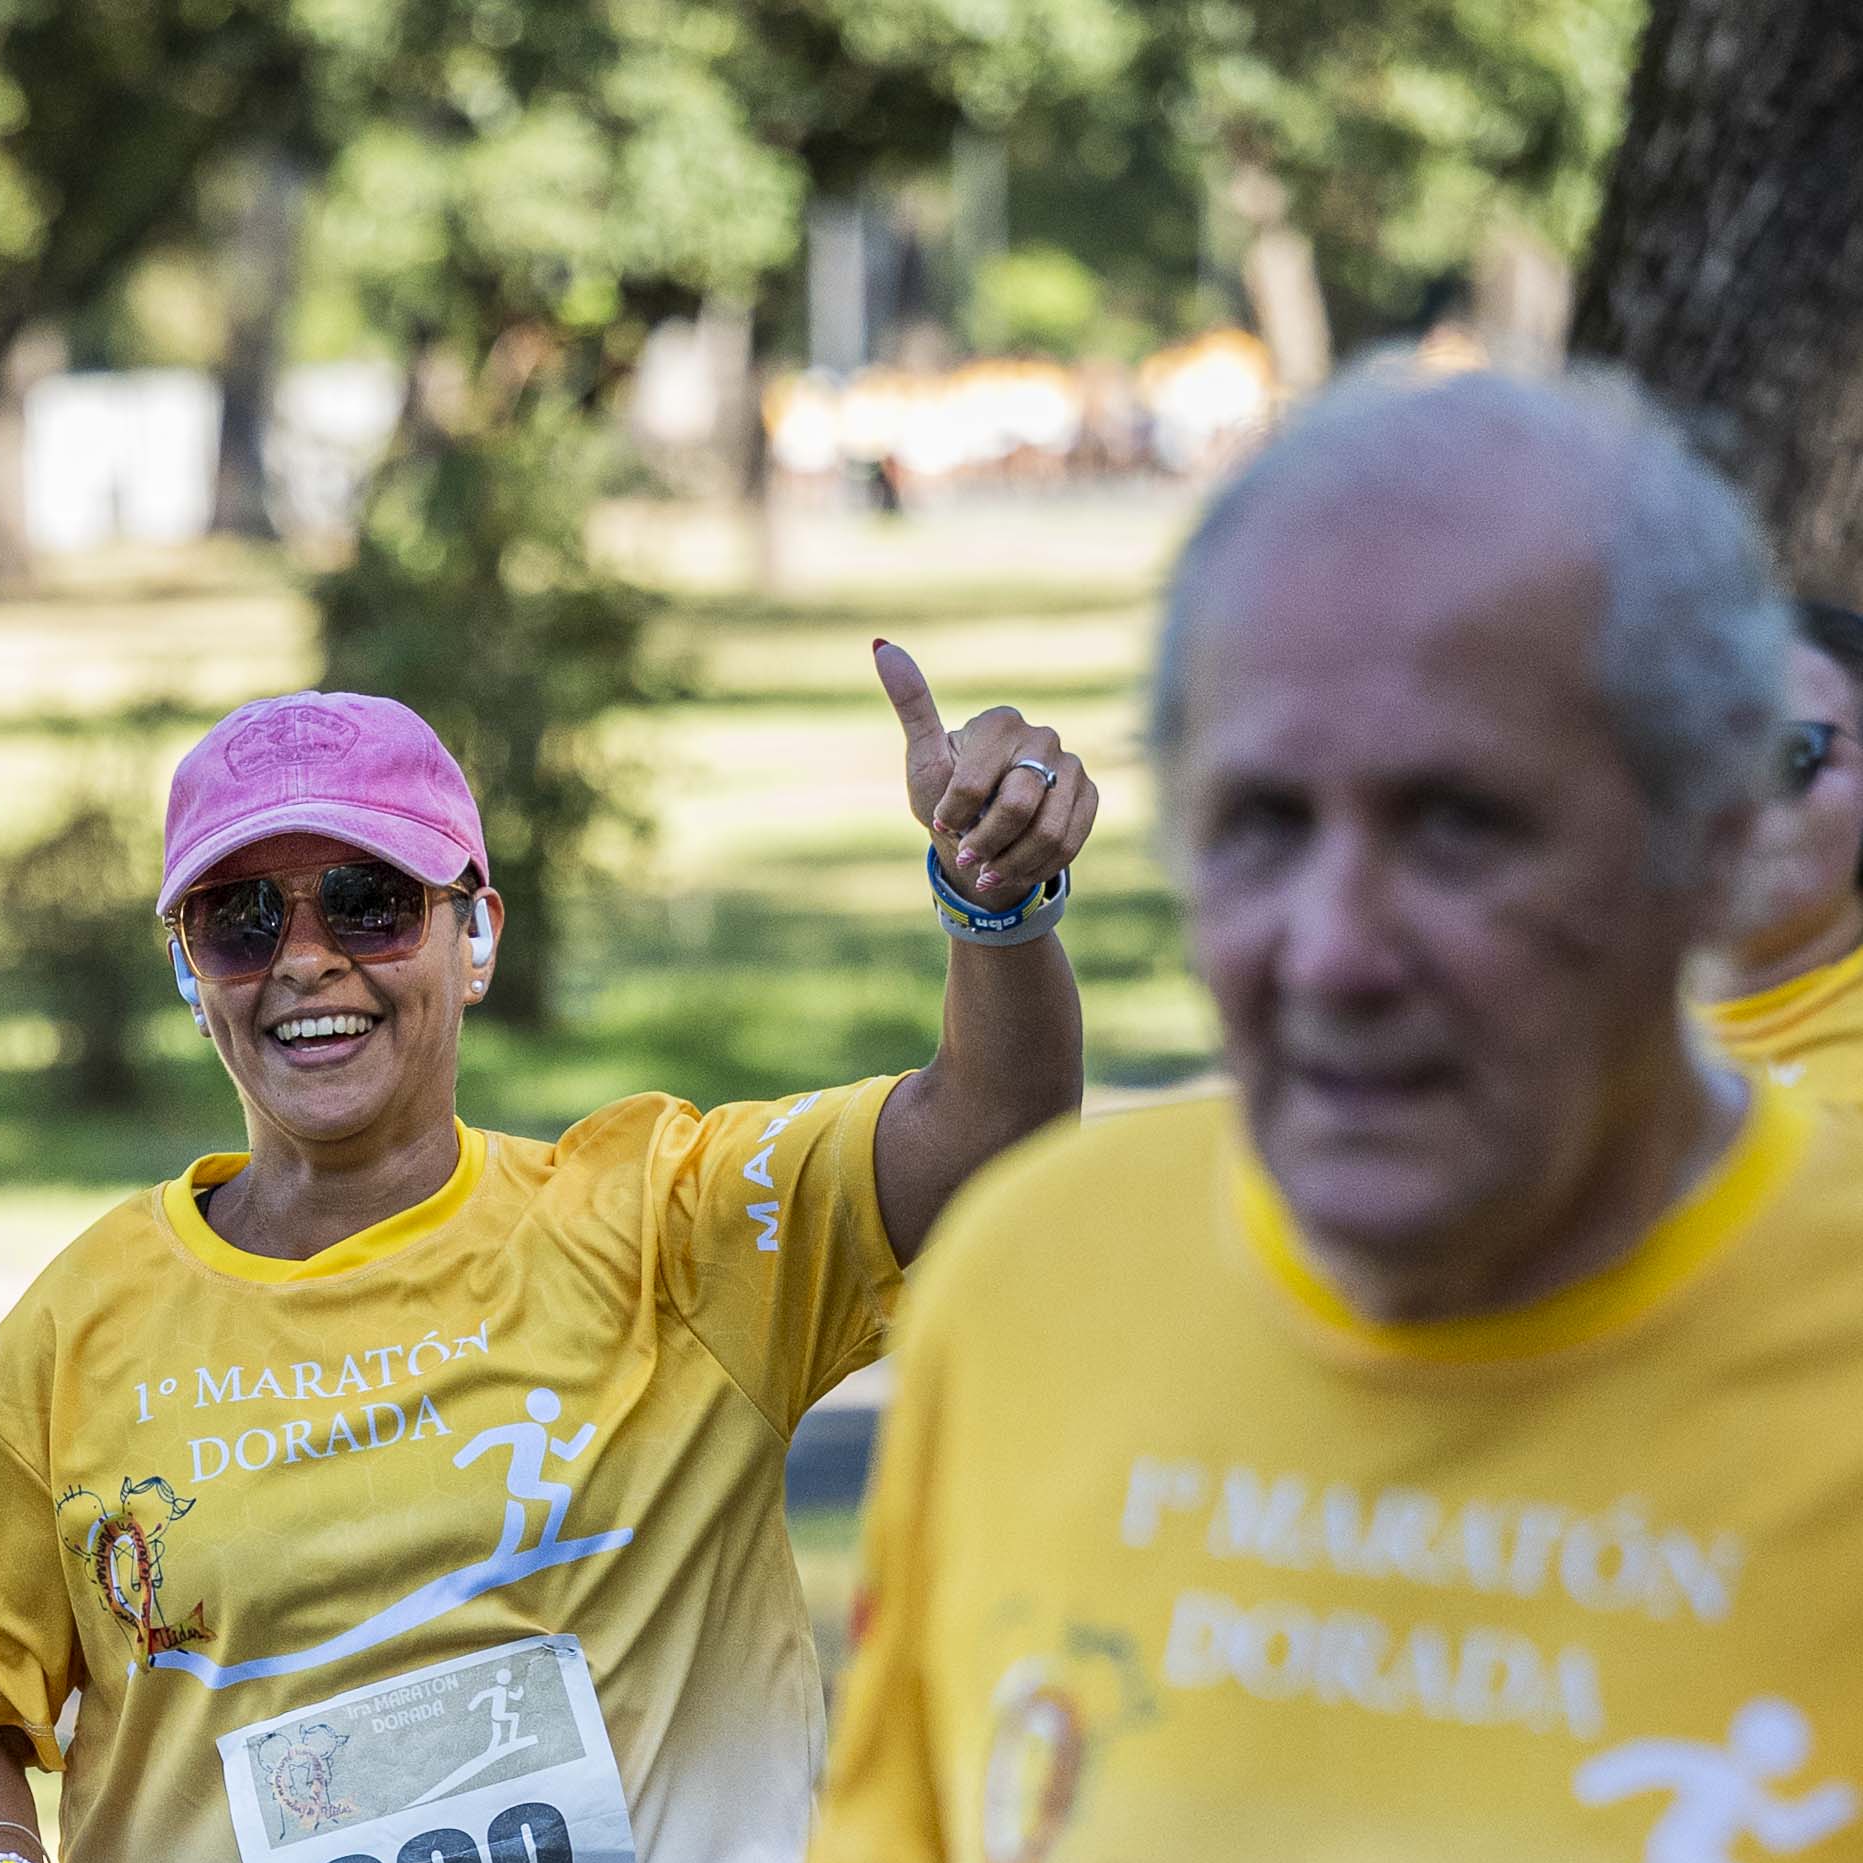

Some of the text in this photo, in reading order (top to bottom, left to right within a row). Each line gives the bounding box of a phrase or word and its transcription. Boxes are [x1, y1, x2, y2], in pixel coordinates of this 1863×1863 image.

[193, 1319, 490, 1408] MARATÓN
[188, 1394, 452, 1484] DORADA
[1162, 1588, 1605, 1741] DORADA
[372, 1698, 446, 1733] DORADA
